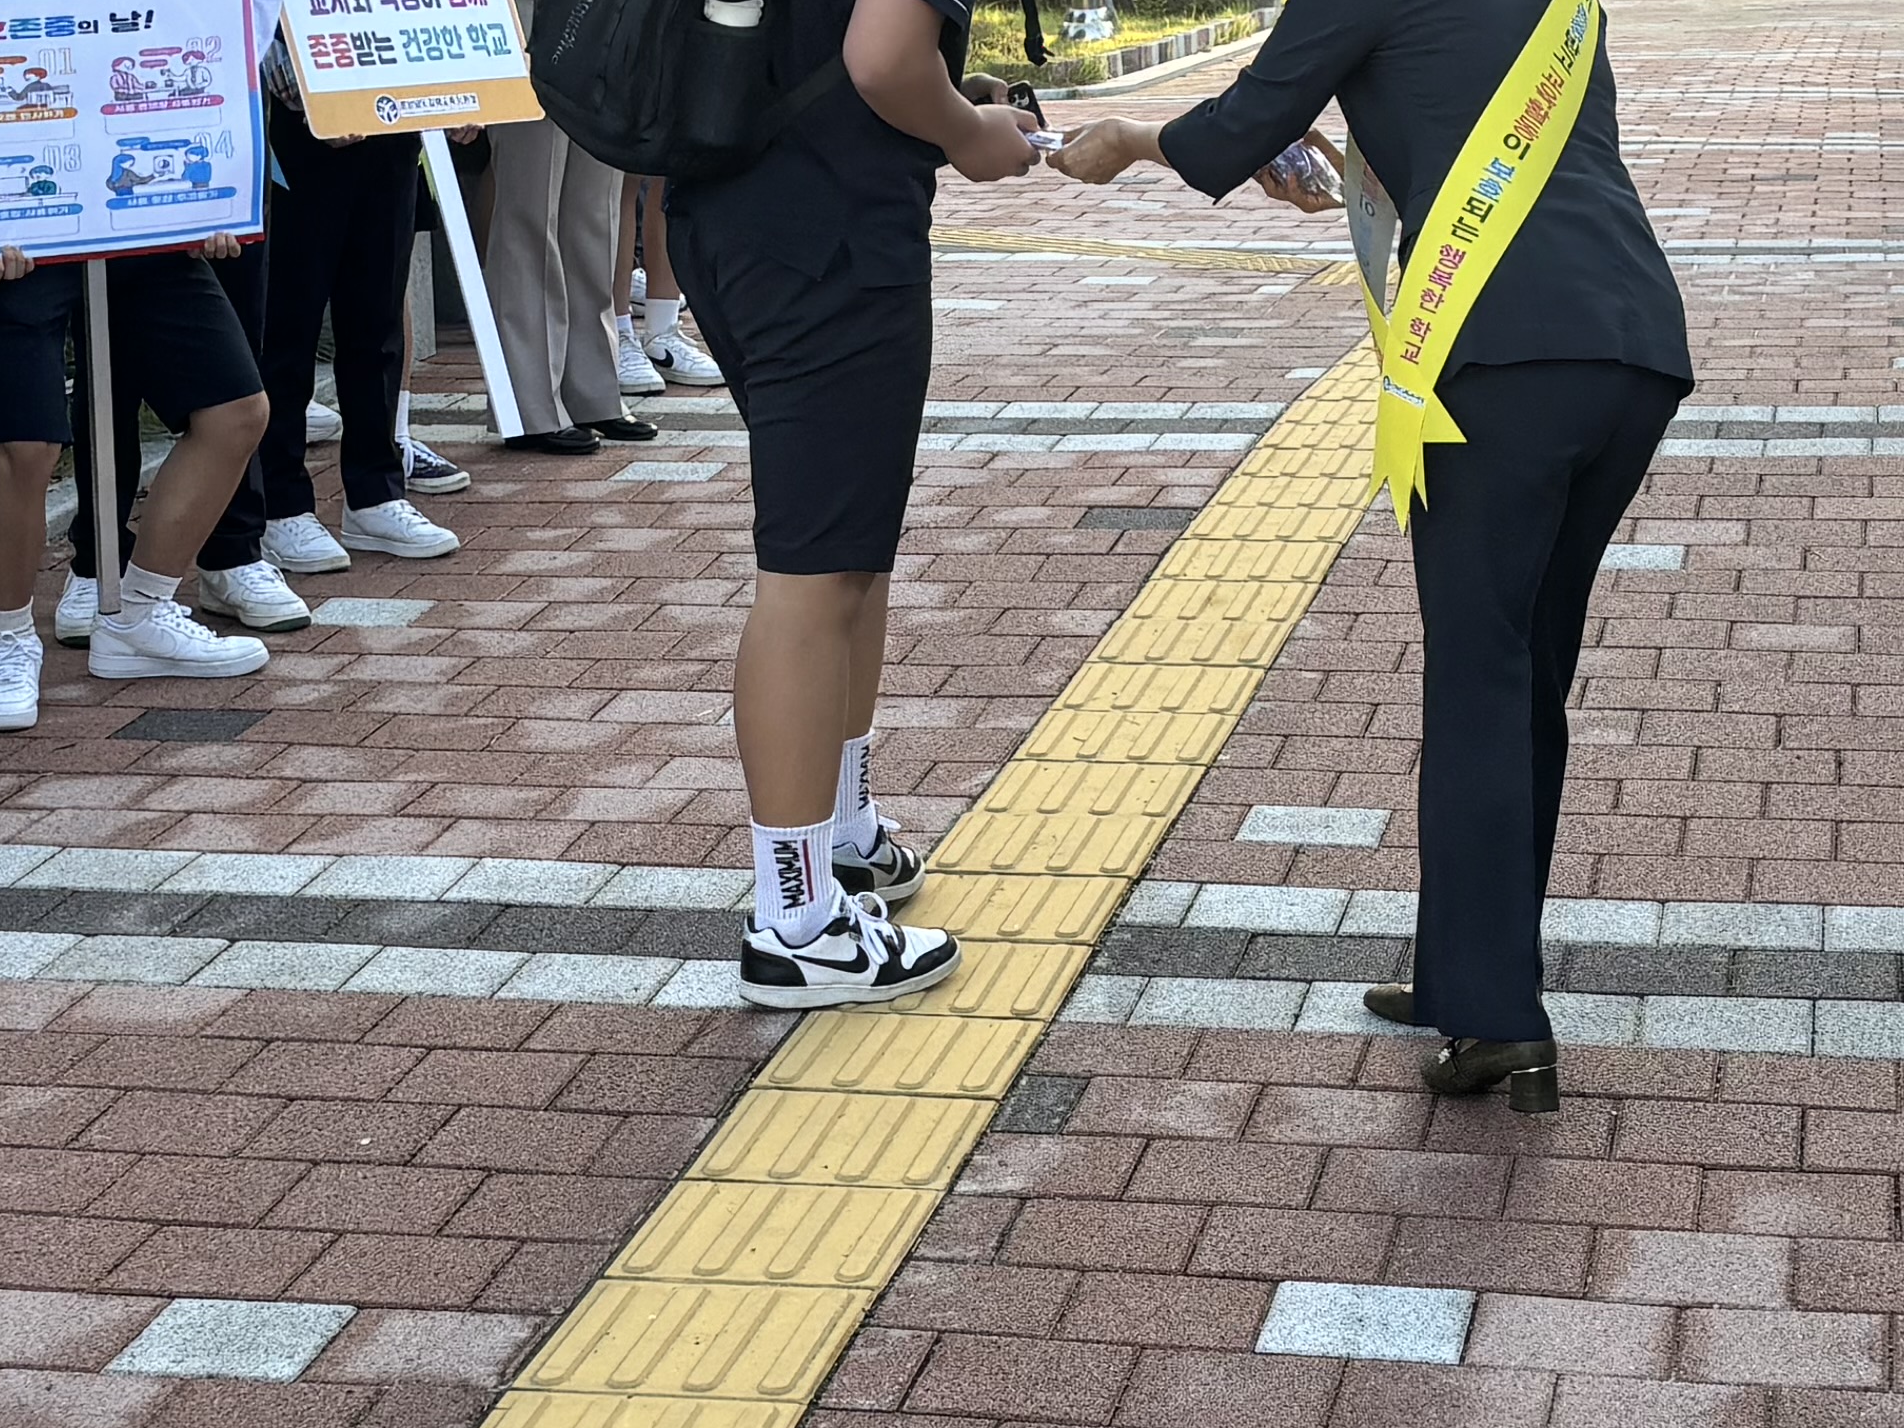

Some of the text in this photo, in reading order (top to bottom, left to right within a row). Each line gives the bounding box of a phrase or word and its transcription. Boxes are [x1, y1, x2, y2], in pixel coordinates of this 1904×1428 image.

[108, 9, 155, 34] 날!
[307, 22, 512, 70] 존중받는 건강한 학교
[1451, 157, 1516, 244] 보호되는
[1420, 243, 1467, 315] 행복한
[1400, 316, 1432, 366] 학교
[772, 839, 806, 910] MAXIMUM
